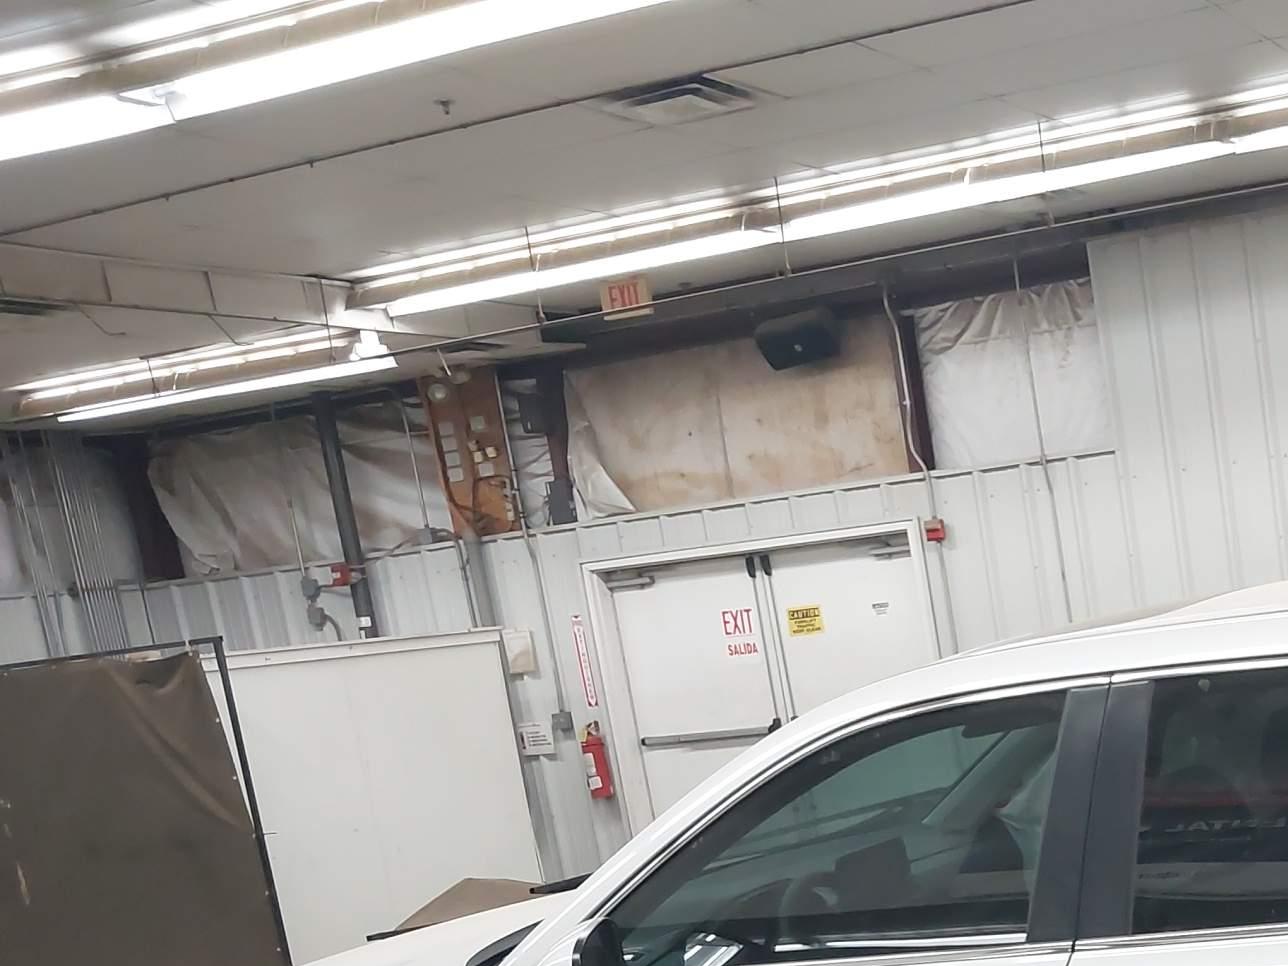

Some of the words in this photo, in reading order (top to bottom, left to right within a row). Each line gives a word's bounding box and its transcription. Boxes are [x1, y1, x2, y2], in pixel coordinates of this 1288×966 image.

[789, 608, 820, 620] CAUTION
[721, 608, 753, 636] EXIT
[727, 642, 758, 656] SALIDA
